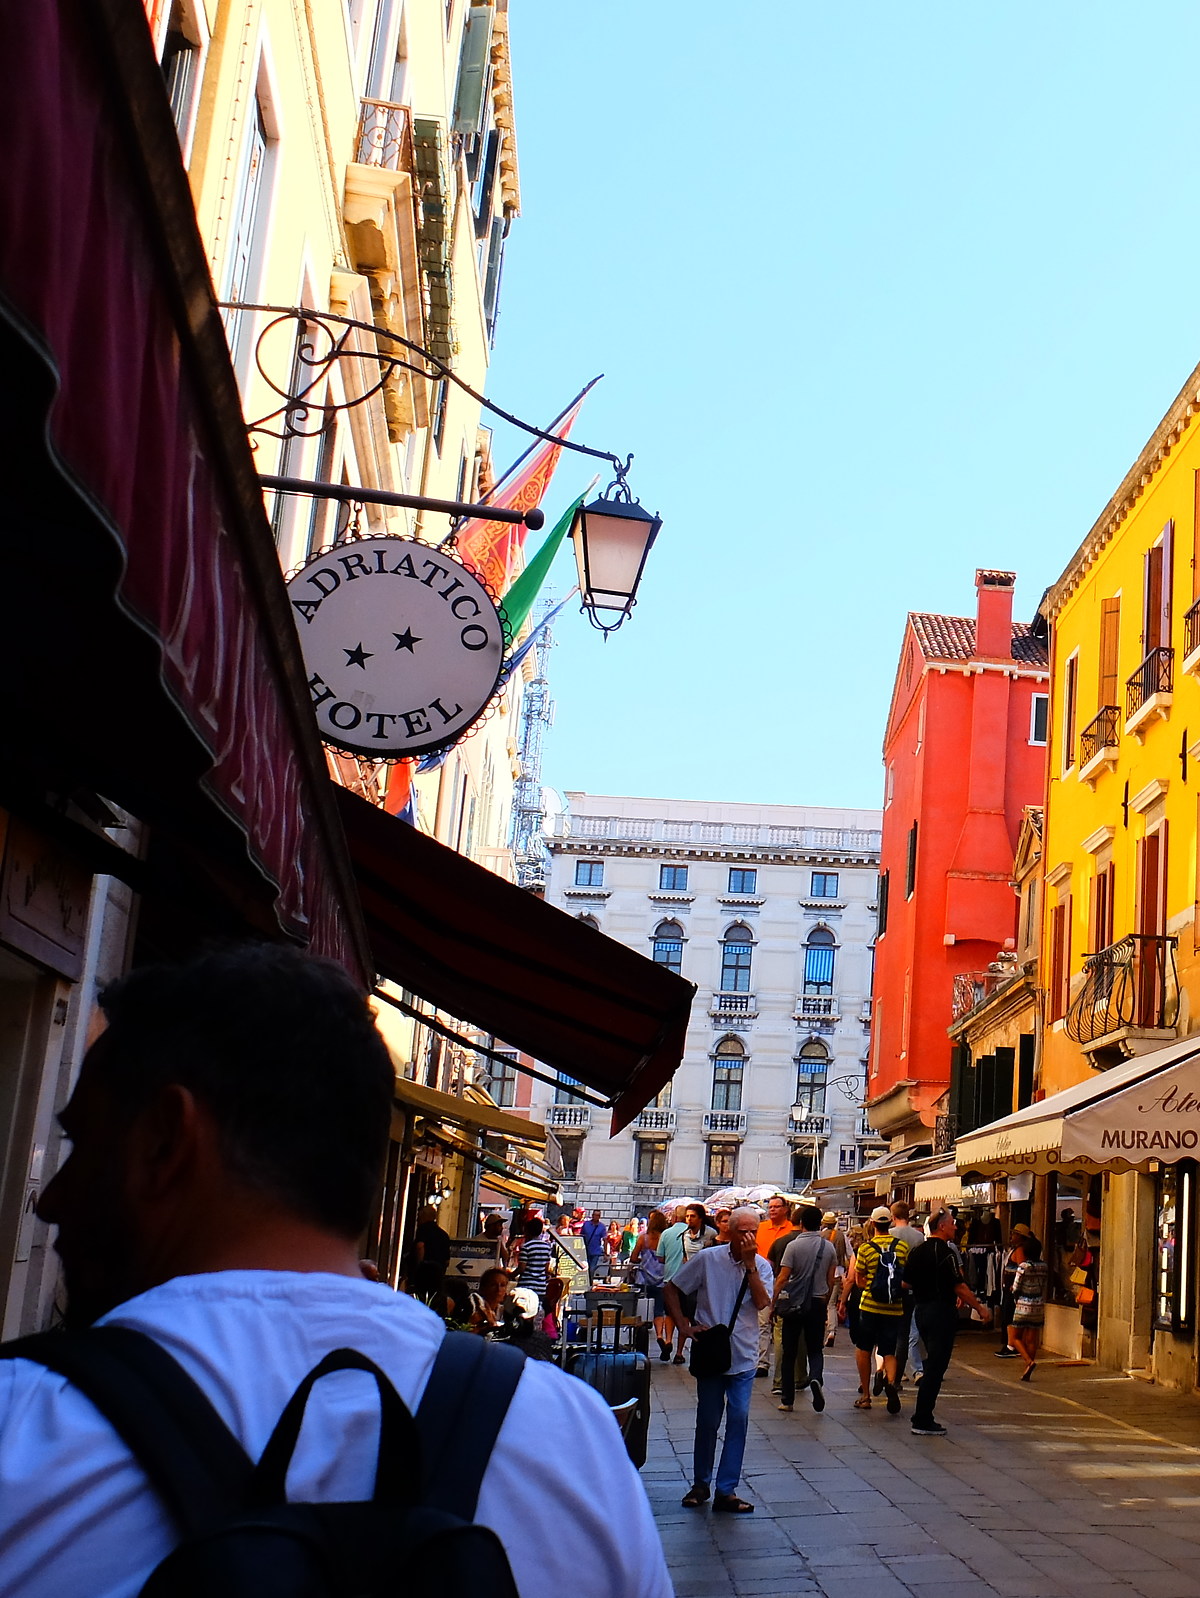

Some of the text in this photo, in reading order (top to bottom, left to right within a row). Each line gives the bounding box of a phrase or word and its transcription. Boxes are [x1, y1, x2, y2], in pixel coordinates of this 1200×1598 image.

[292, 550, 488, 652] ADRIATICO
[308, 673, 463, 740] HOTEL
[1101, 1129, 1199, 1150] MURANO
